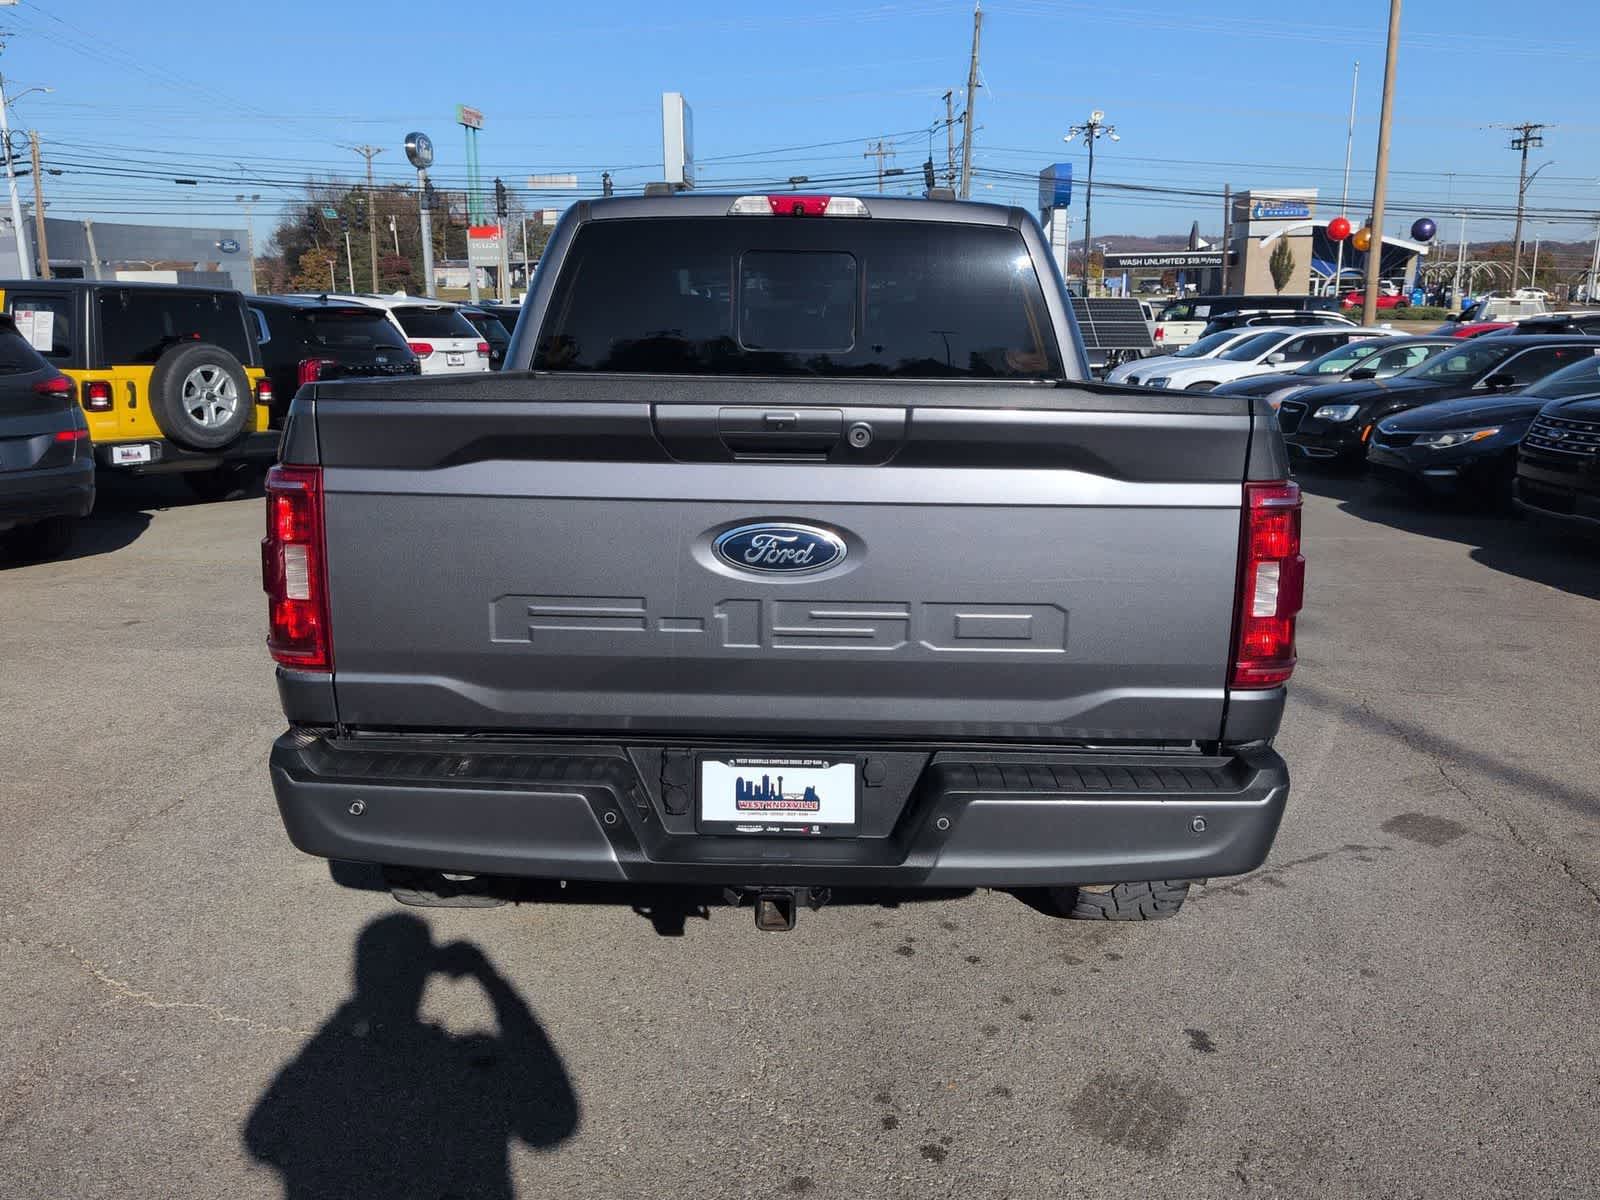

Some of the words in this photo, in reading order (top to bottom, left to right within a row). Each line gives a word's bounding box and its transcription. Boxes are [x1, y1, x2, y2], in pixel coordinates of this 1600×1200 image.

[1119, 258, 1142, 266] WASH
[1144, 257, 1186, 265] UNLIMITED
[744, 533, 816, 564] Ford
[489, 593, 1068, 654] F-150
[739, 801, 765, 809] WEST
[766, 801, 818, 810] KNOXVILLE
